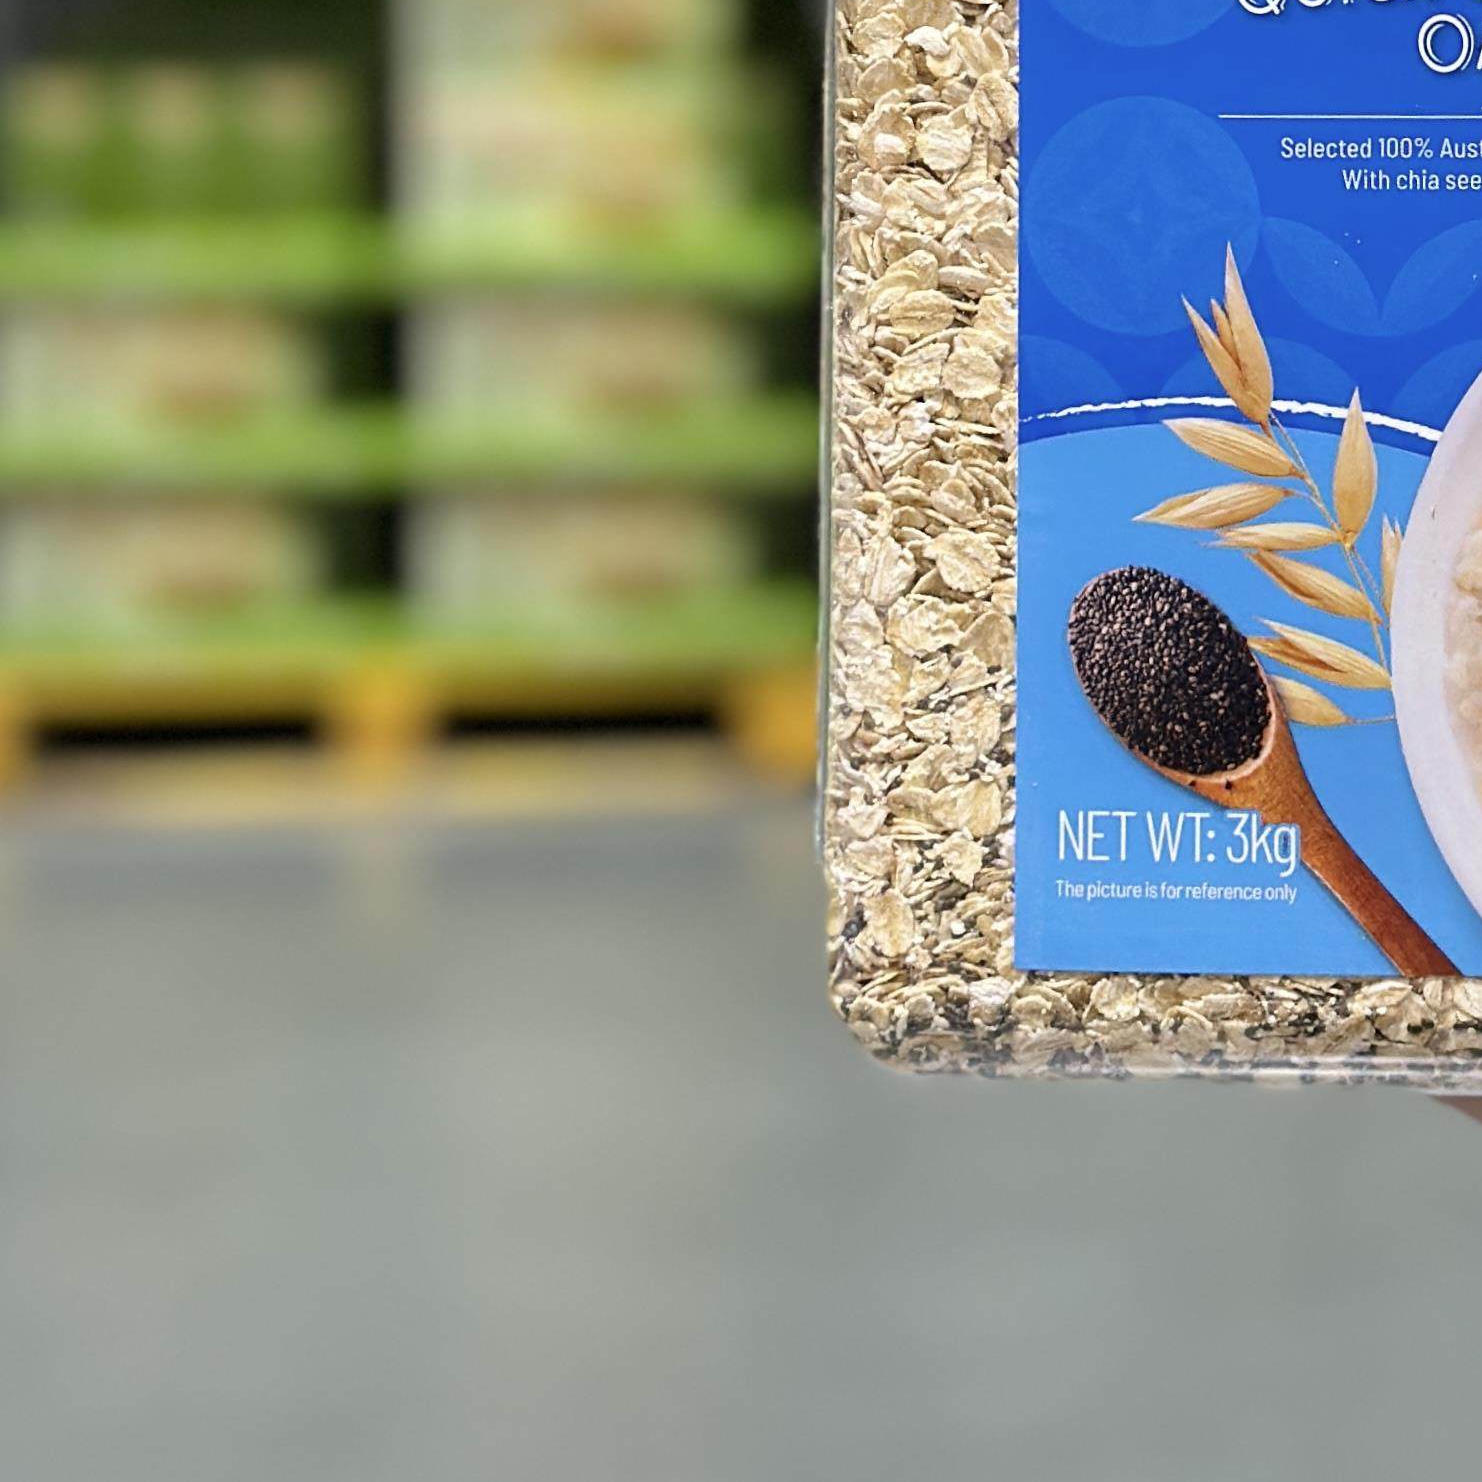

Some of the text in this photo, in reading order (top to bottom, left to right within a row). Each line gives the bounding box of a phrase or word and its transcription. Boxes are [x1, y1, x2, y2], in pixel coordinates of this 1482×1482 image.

[1280, 137, 1372, 160] Selected
[1378, 137, 1434, 160] 100%
[1342, 169, 1390, 191] With
[1396, 169, 1440, 191] chia
[1058, 810, 1297, 878] NET WT: 3kg
[1055, 880, 1298, 905] The picture is for reference only
